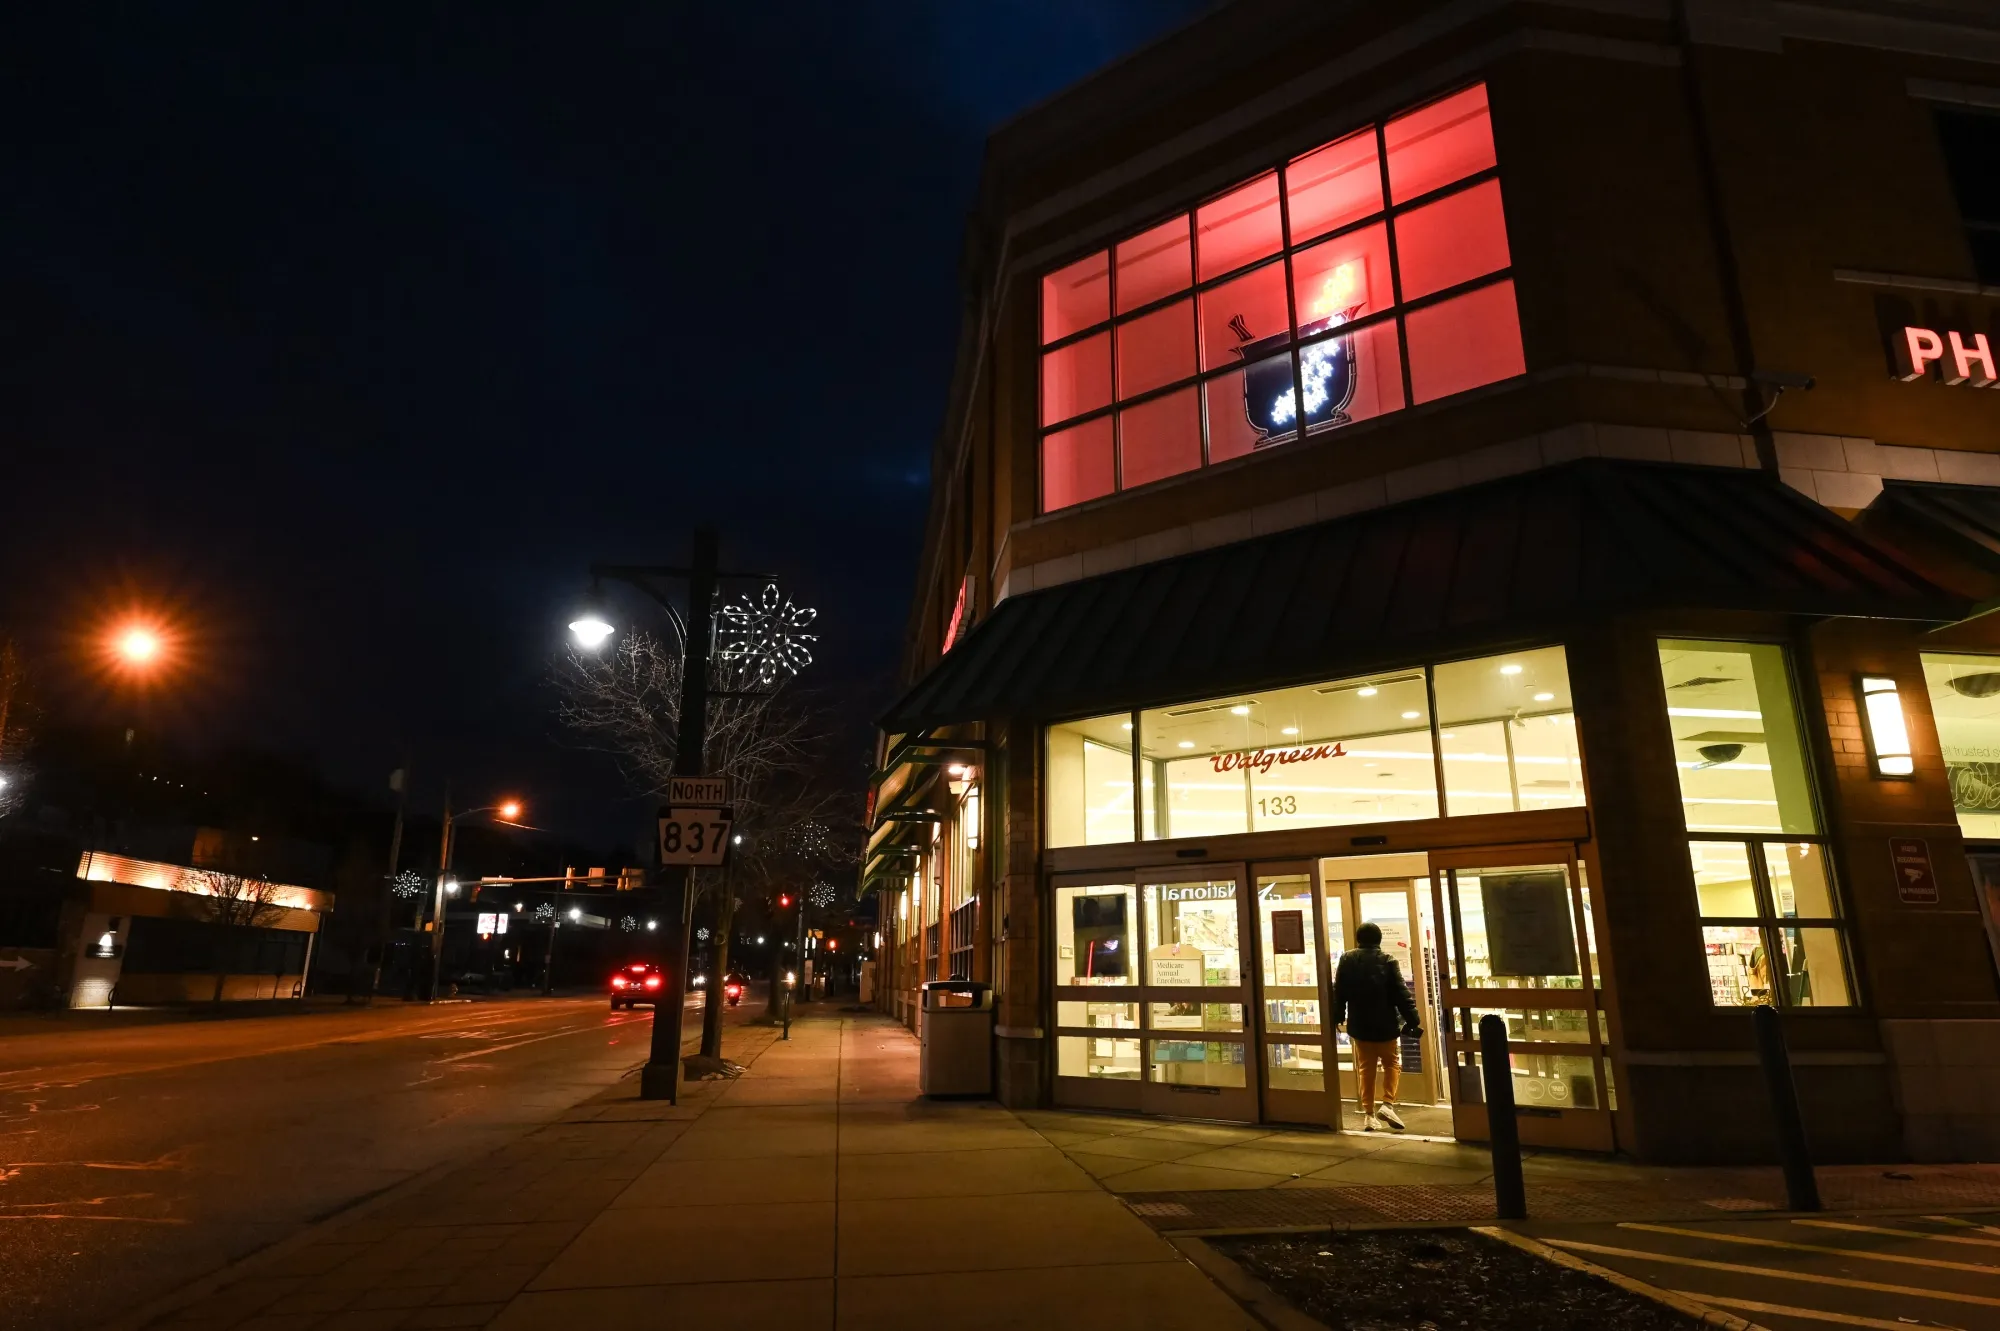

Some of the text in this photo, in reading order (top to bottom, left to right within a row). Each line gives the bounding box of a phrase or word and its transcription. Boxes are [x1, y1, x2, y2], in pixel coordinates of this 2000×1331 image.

[1209, 742, 1348, 774] Walgreens
[1953, 745, 1990, 757] trusted
[672, 781, 723, 800] NORTH
[1258, 795, 1297, 817] 133
[664, 822, 727, 854] 837
